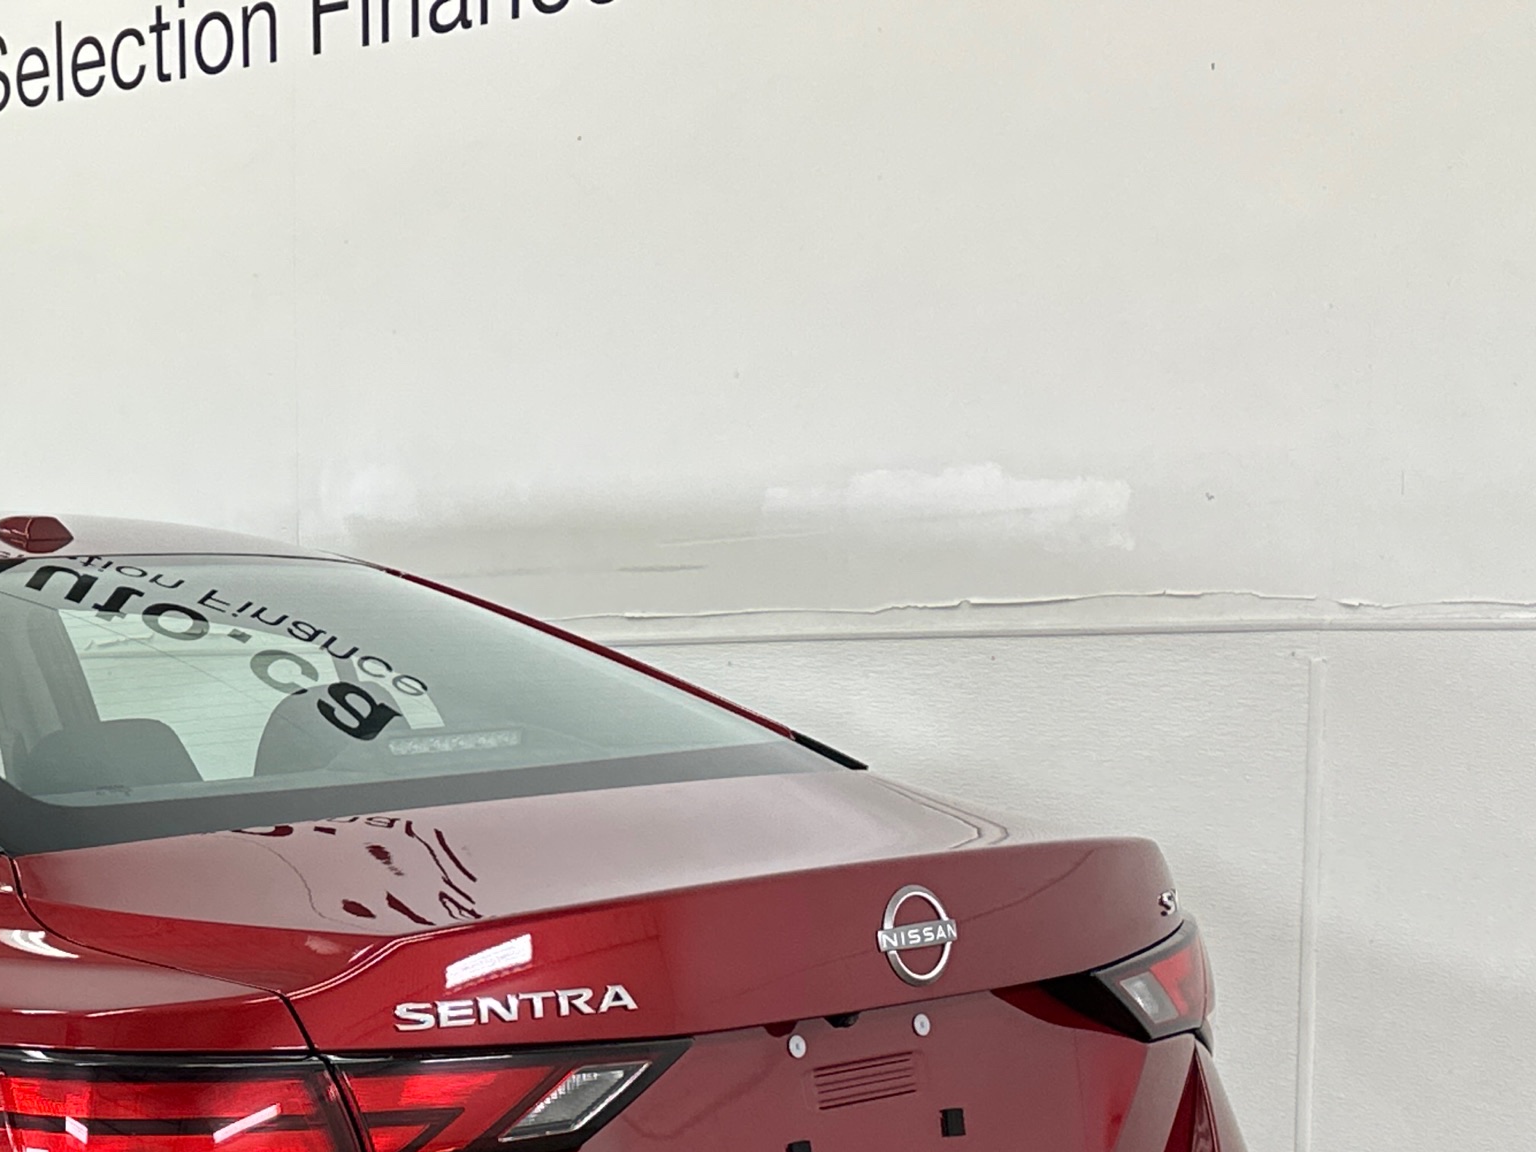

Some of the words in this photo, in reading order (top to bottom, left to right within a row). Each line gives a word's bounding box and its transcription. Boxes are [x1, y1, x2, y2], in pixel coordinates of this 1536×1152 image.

[312, 0, 621, 55] Fina
[881, 924, 957, 949] NISSAN
[393, 984, 639, 1031] SENTRA
